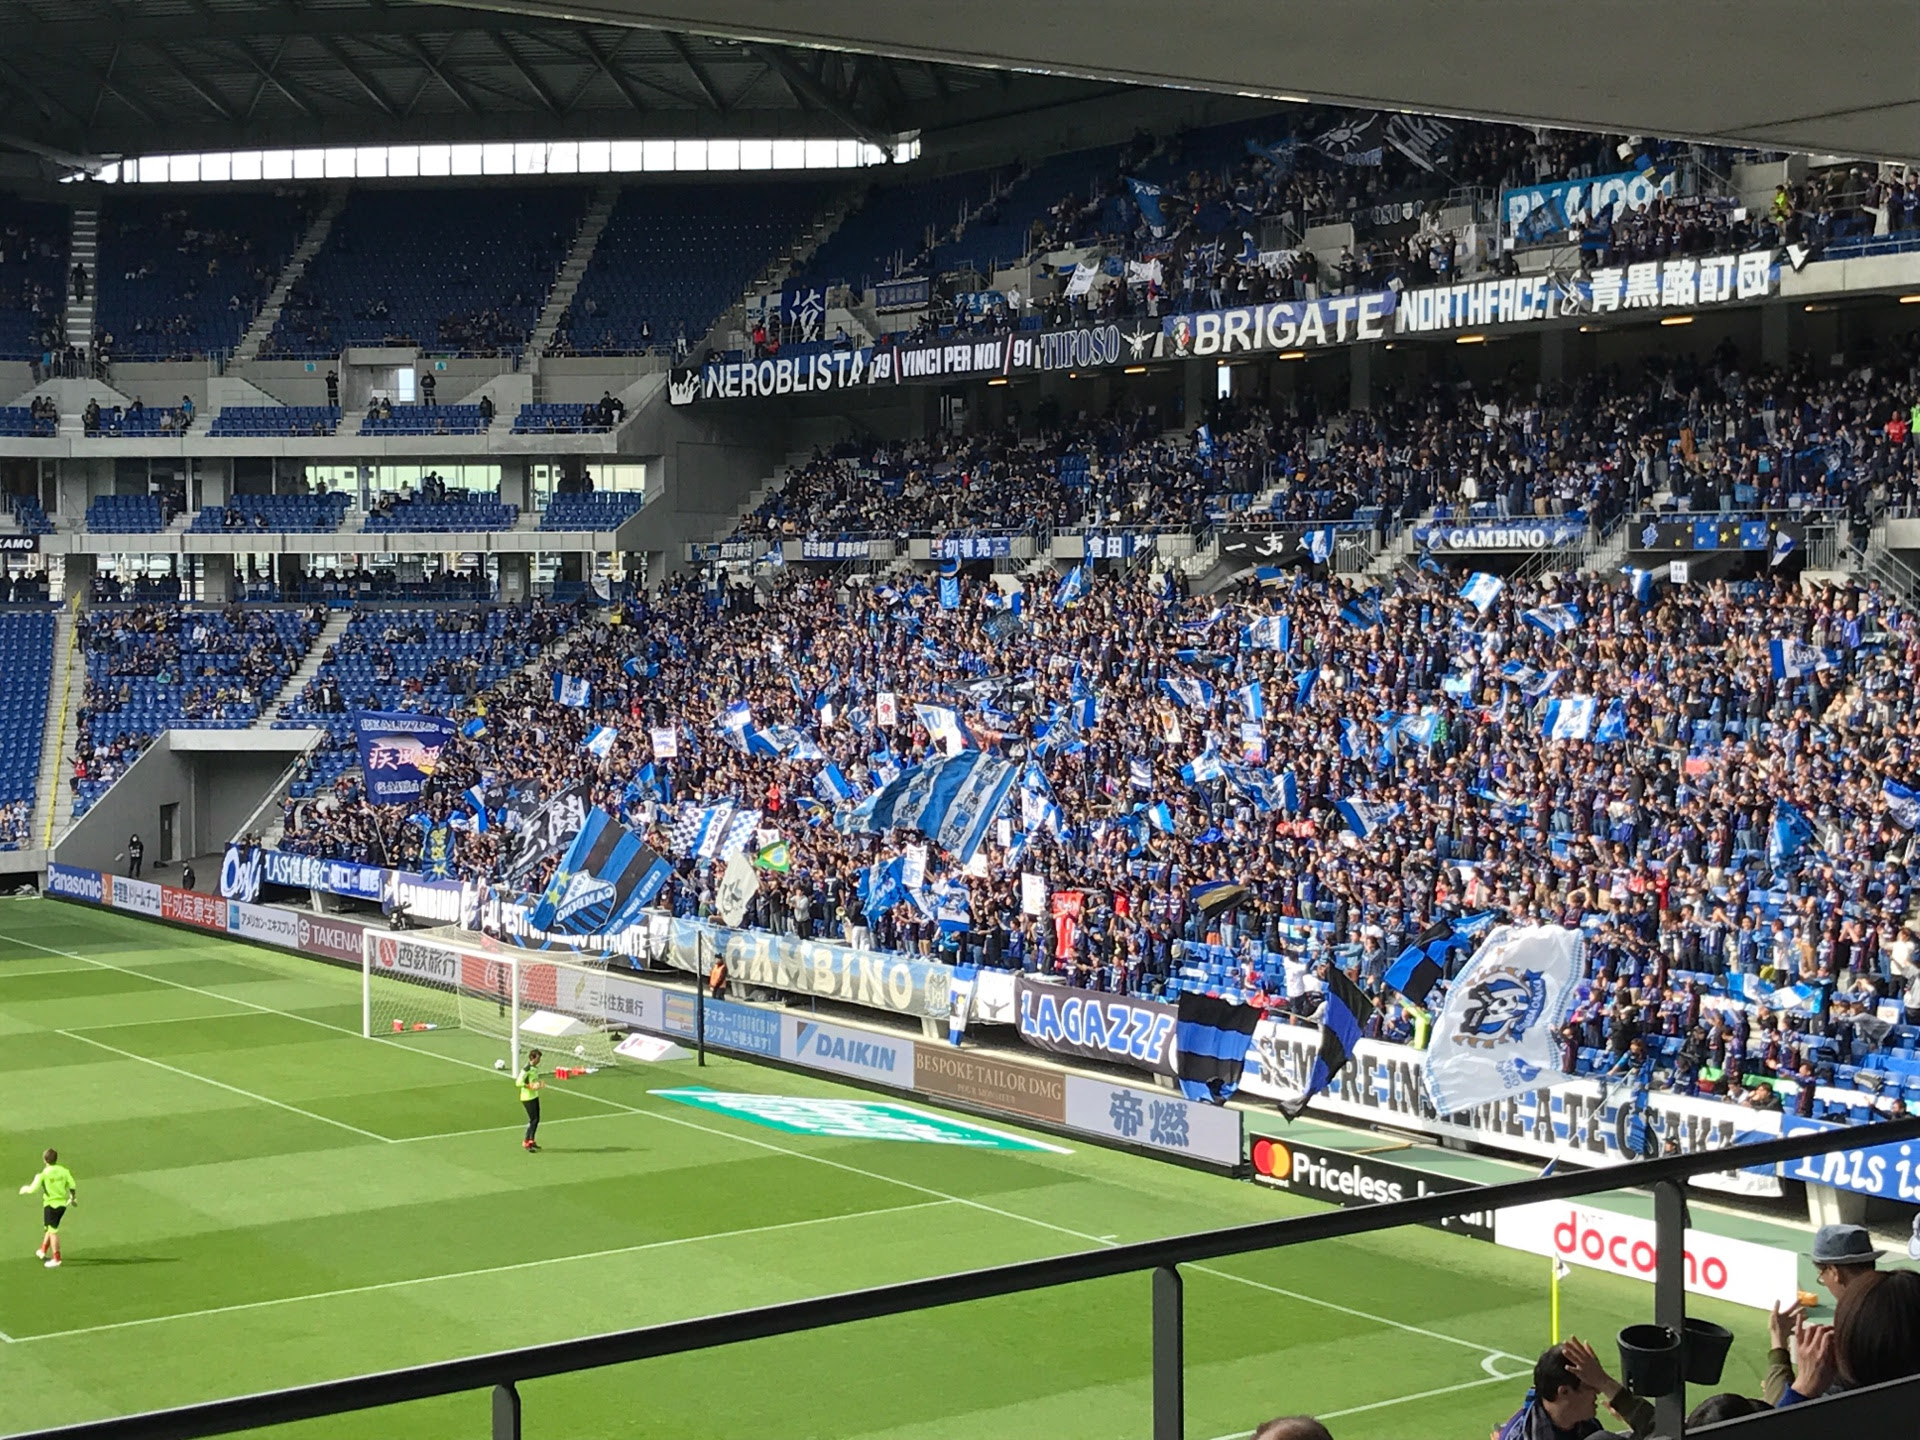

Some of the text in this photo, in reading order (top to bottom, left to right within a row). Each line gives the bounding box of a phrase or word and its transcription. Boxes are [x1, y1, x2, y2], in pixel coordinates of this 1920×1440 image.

[1041, 325, 1121, 370] TIFOSO
[1194, 294, 1385, 356] BRIGATE
[706, 351, 864, 398] NEROBLISTA
[902, 346, 941, 378] VINCI
[945, 343, 972, 373] PER
[974, 342, 1001, 371] NOI
[1450, 529, 1546, 549] GAMBINO
[48, 864, 101, 899] Panasonic
[163, 889, 226, 929] 平成医療学園
[726, 936, 913, 1009] GAMBINO
[1021, 989, 1175, 1064] LAGAZZE
[816, 1032, 897, 1072] DAIKIN
[1259, 1036, 1379, 1108] SEMRE
[916, 1053, 1062, 1101] BESPOKE TAILOR DMG
[1108, 1090, 1190, 1148] 帝燃
[1293, 1152, 1403, 1204] Priceless
